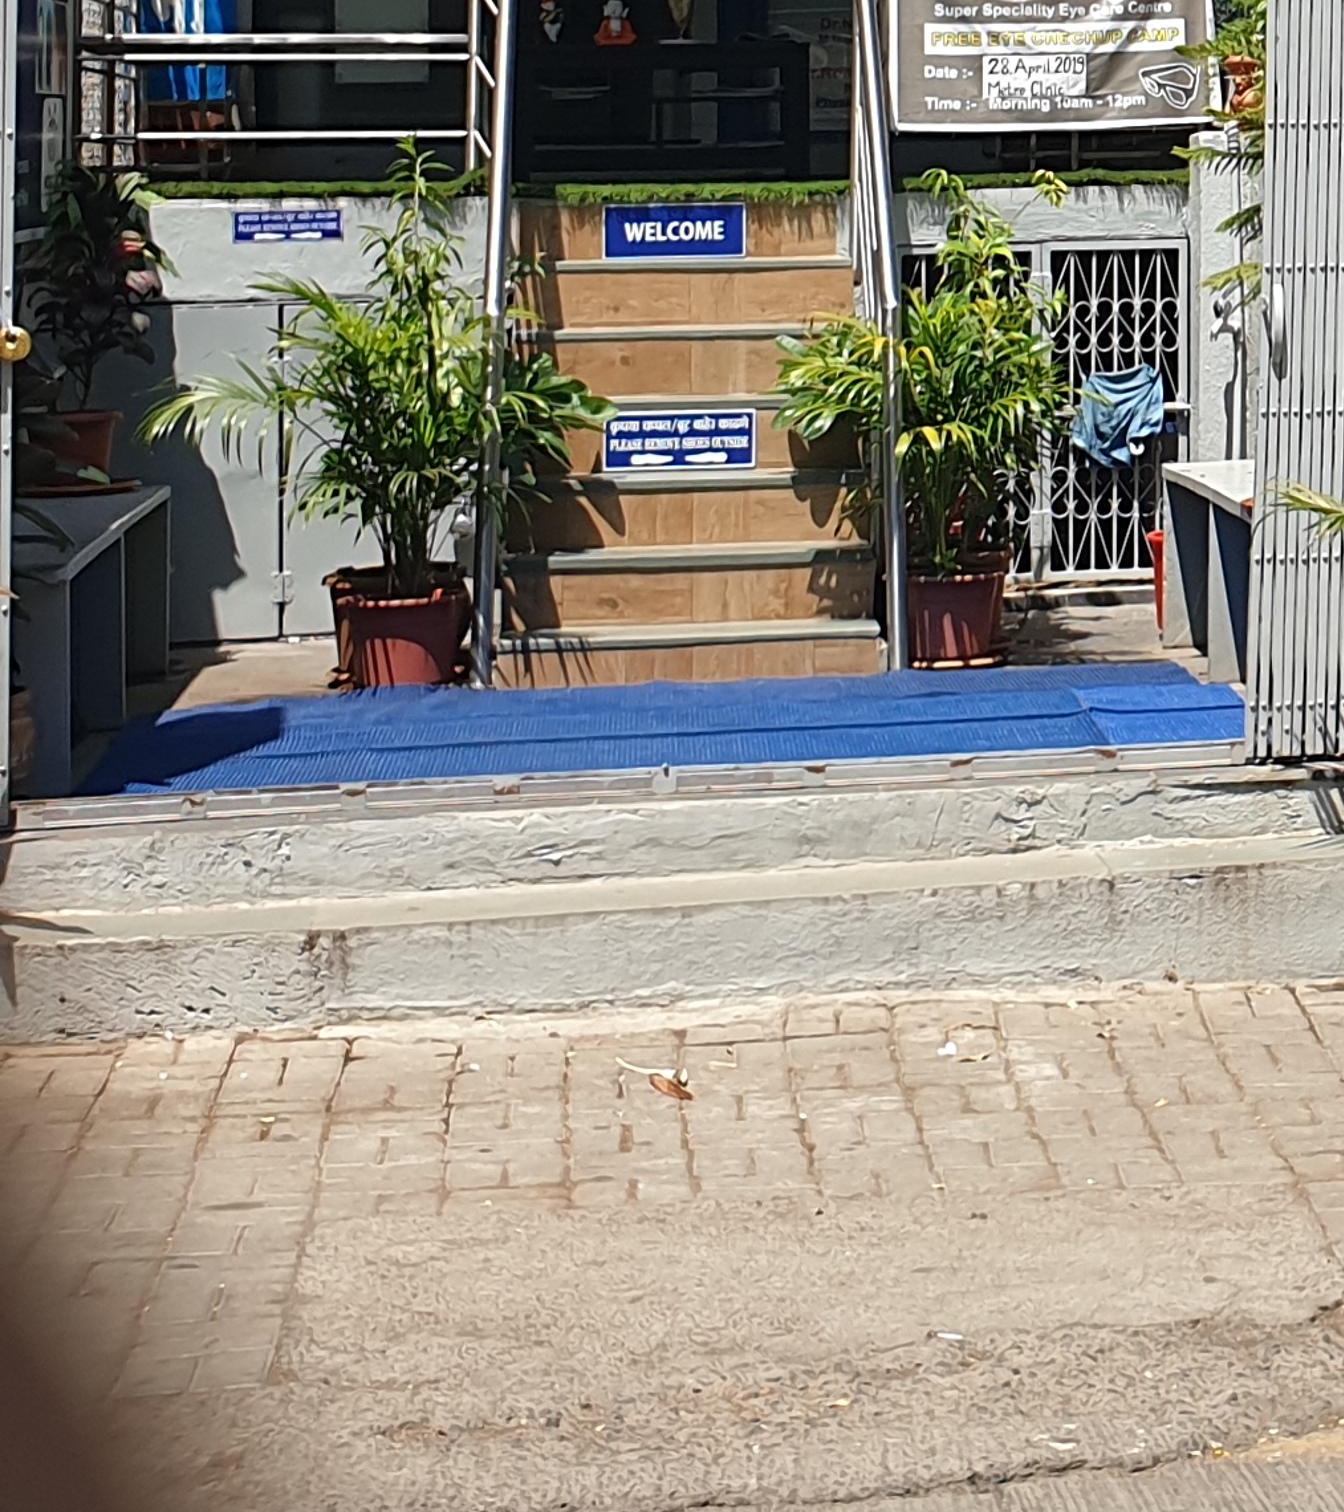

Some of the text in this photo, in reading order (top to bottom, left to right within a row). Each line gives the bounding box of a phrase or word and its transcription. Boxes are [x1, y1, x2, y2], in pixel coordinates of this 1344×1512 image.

[934, 1, 1172, 18] Super Speciality Eye Care Centre
[924, 65, 958, 78] Date
[625, 221, 724, 241] WELCOME
